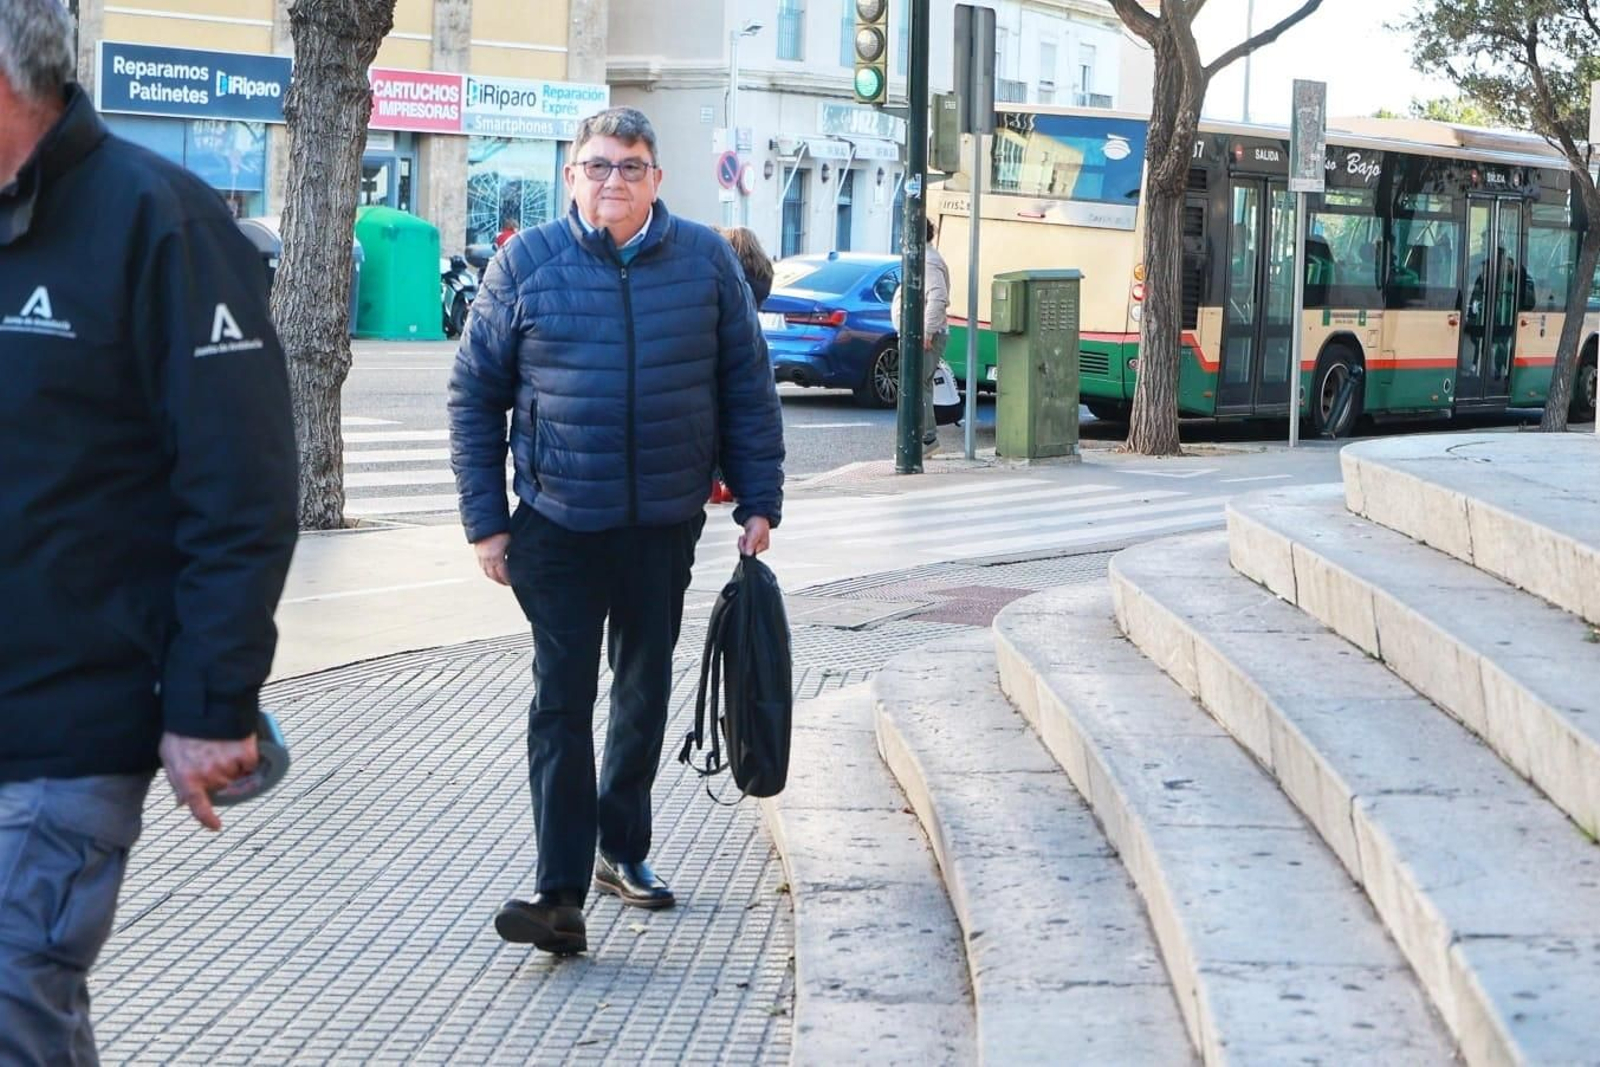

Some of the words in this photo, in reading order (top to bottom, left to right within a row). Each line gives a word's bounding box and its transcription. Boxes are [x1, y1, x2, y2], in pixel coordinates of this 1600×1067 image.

[113, 55, 209, 81] Reparamos
[129, 81, 209, 104] Patinetes
[227, 75, 281, 99] iRiparo
[373, 79, 460, 101] CARTUCHOS
[479, 83, 537, 110] iRiparo
[542, 84, 605, 102] Reparación
[378, 103, 459, 120] IMPRESORAS
[542, 100, 579, 116] Exprés
[475, 116, 554, 136] Smartphones
[1255, 148, 1279, 161] SALIDA
[1347, 153, 1381, 182] Bajo
